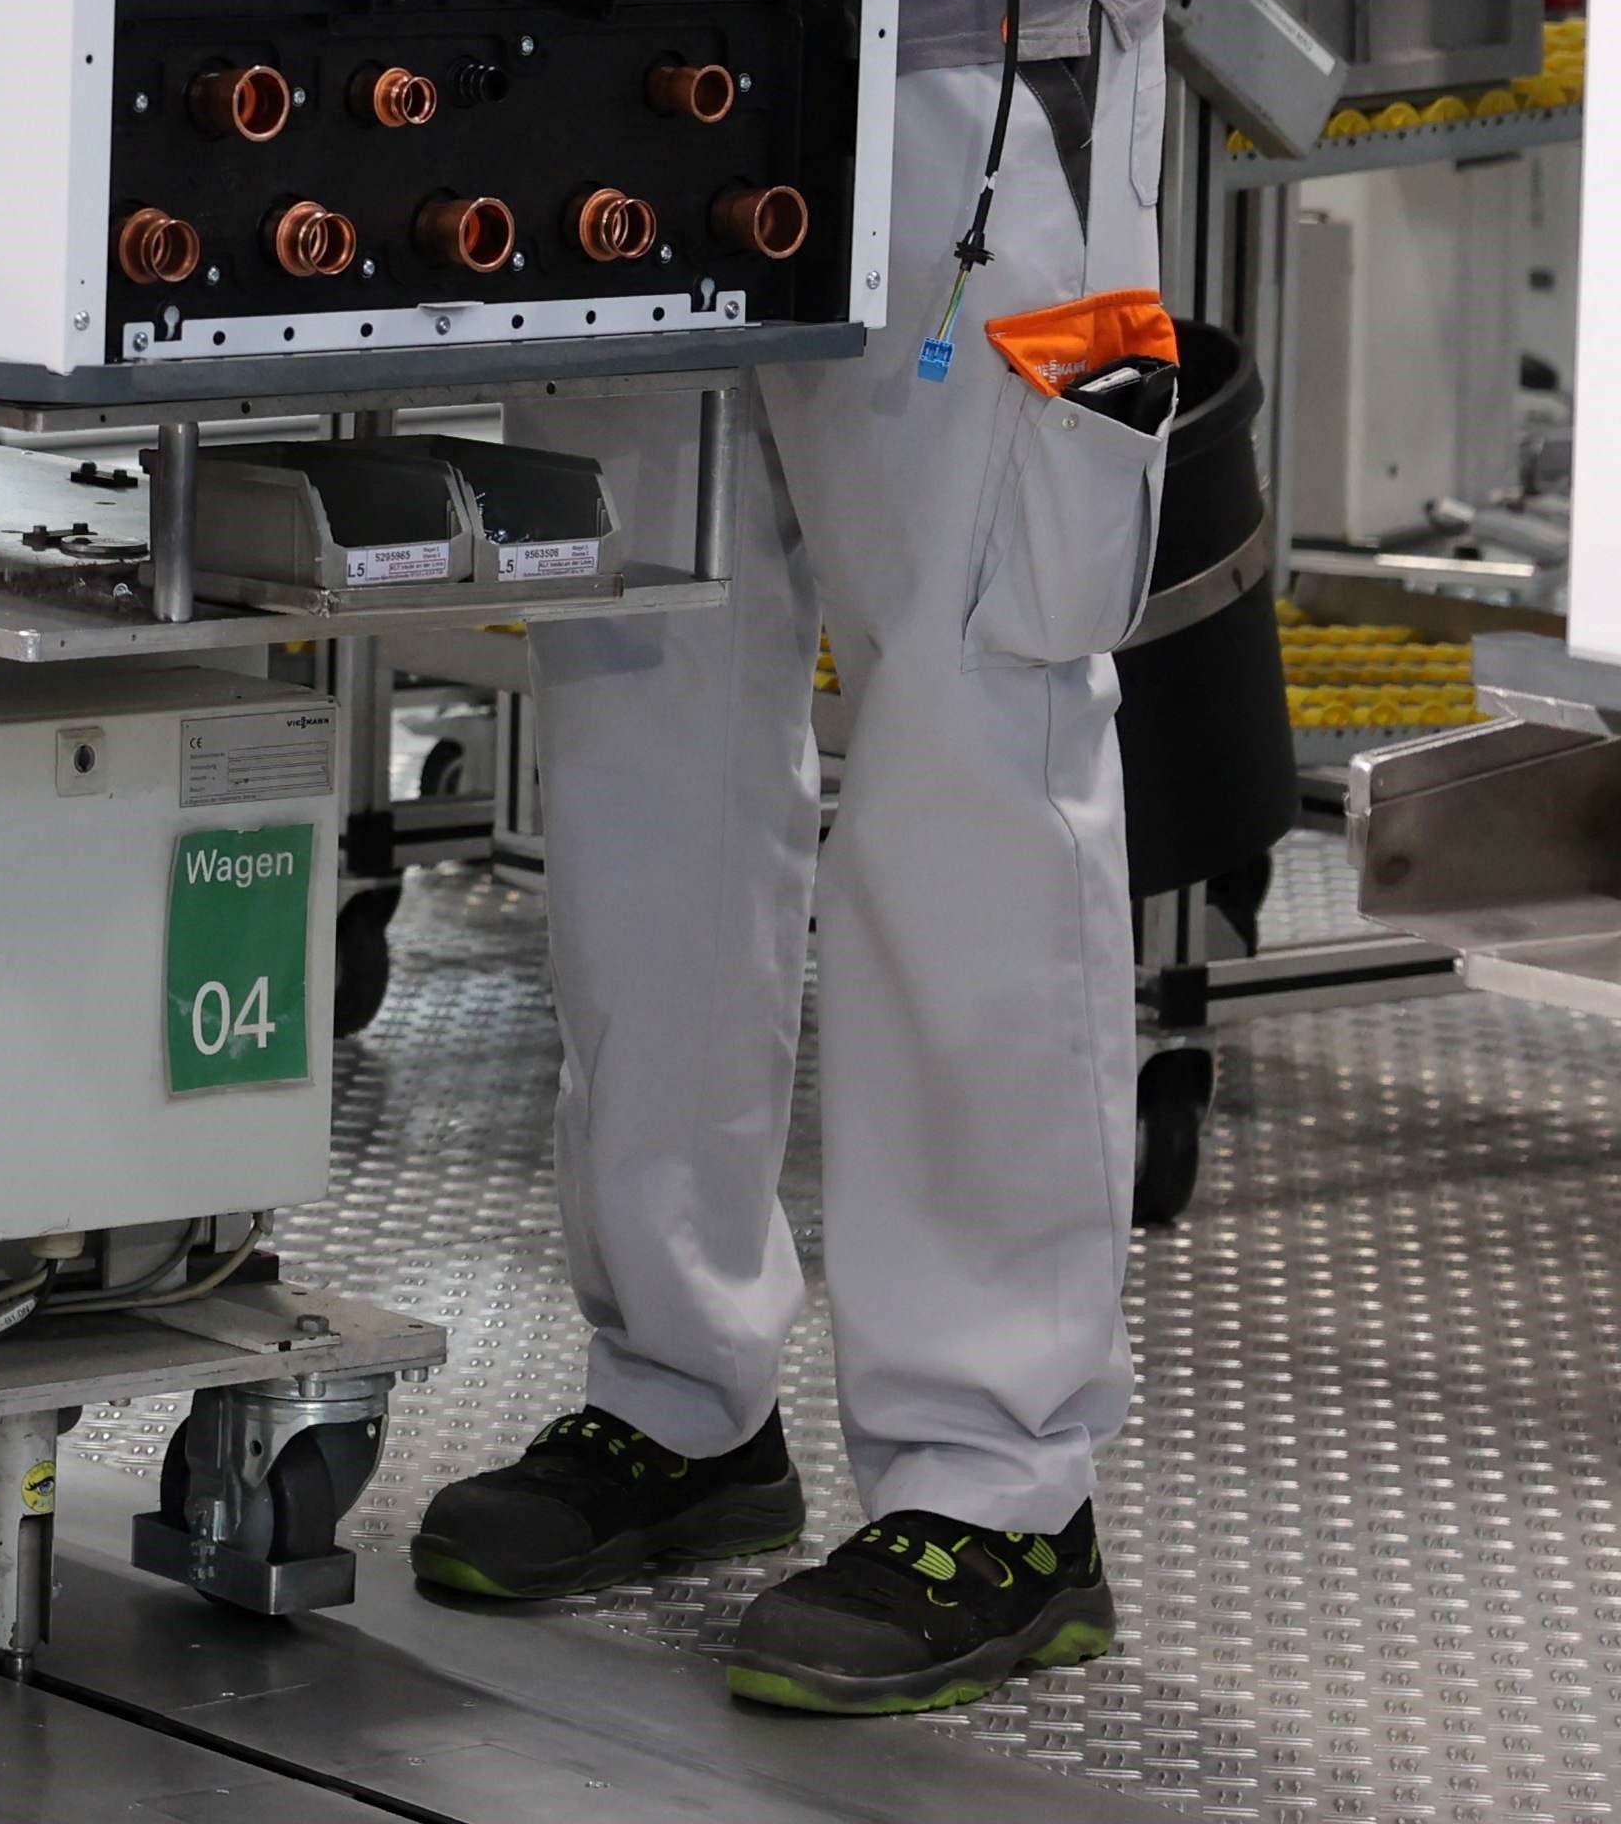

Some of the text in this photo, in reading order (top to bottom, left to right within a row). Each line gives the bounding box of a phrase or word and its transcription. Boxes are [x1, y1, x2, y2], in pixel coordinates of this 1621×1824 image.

[348, 562, 366, 578] L5
[186, 849, 294, 888] Wagen
[192, 976, 276, 1056] 04
